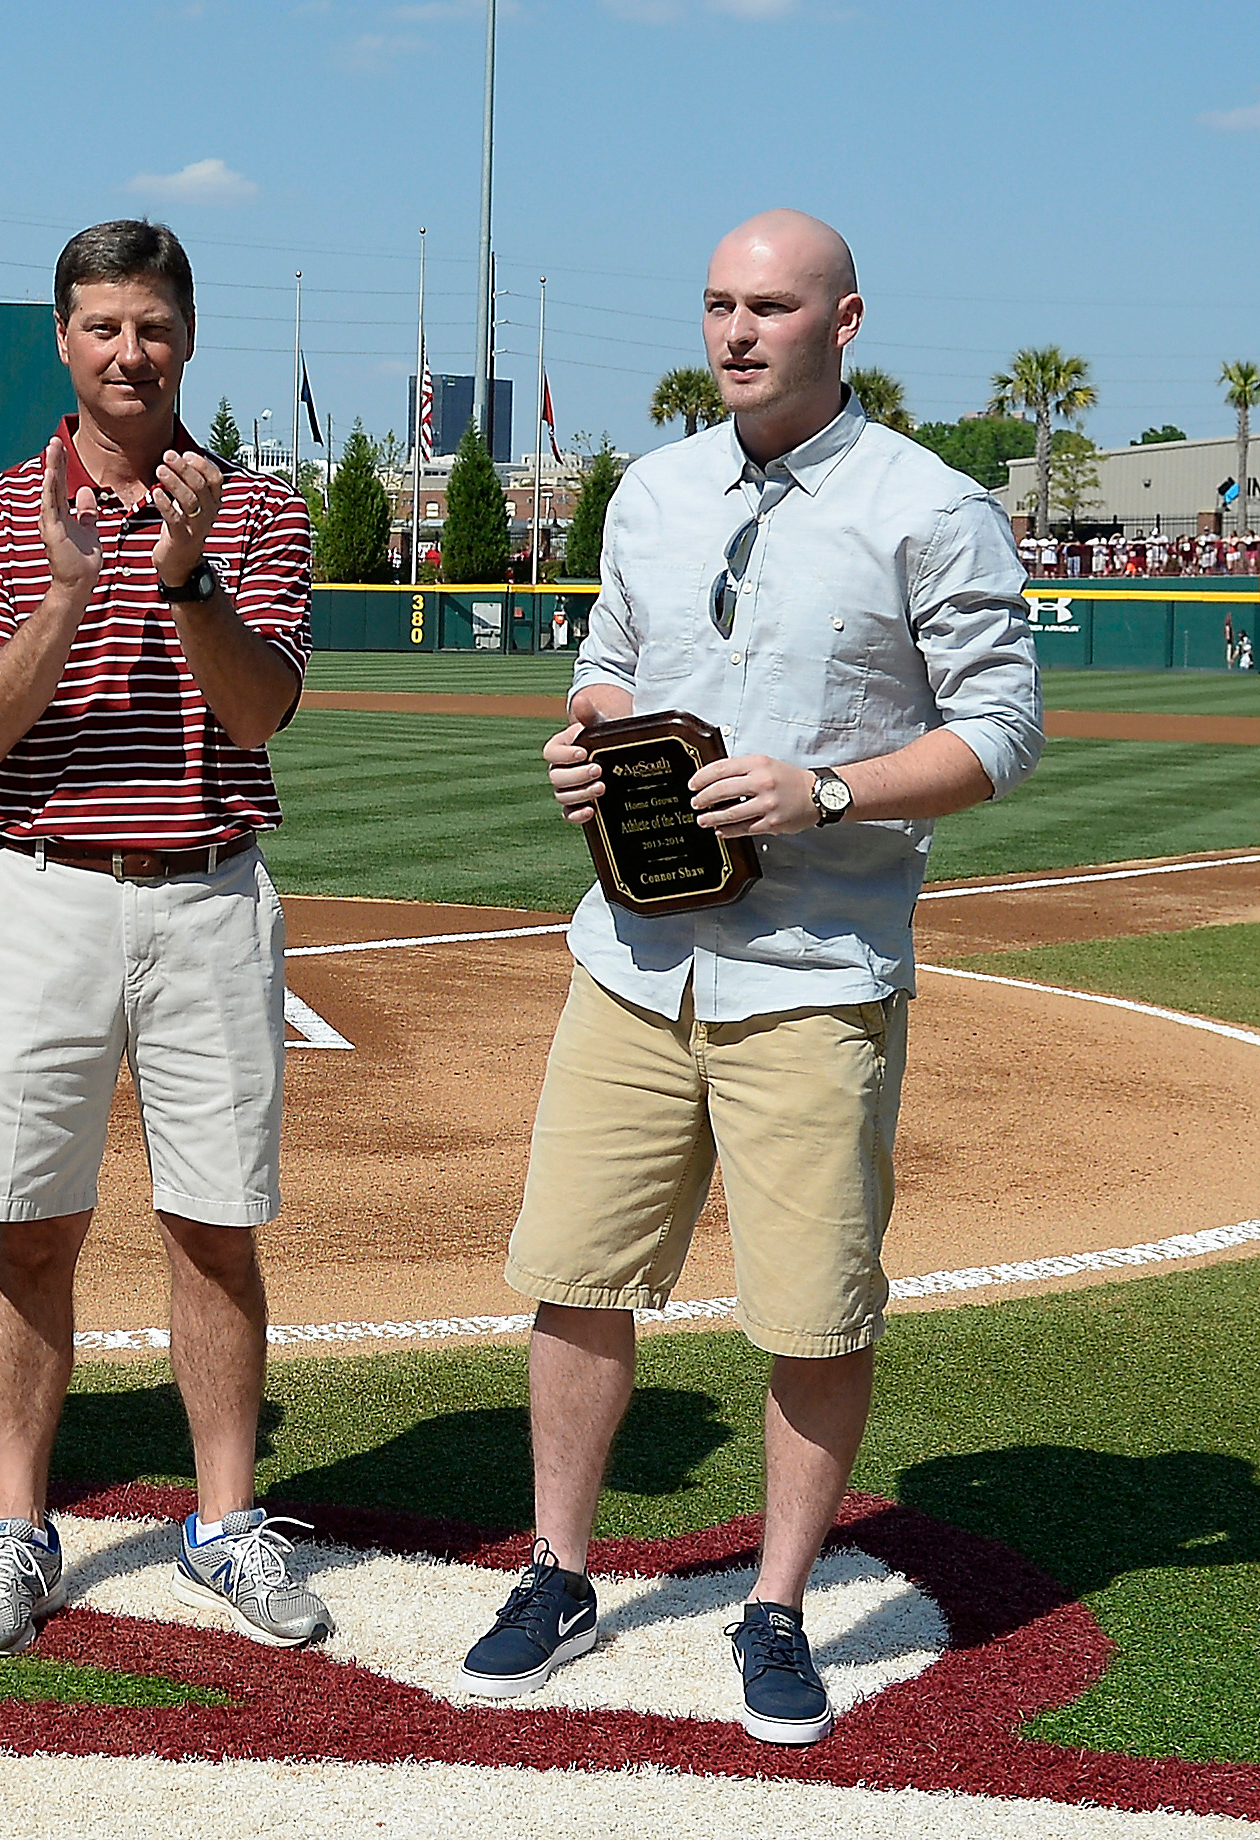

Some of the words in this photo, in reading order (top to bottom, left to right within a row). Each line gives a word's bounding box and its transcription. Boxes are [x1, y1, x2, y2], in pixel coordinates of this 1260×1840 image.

[411, 594, 424, 644] 380
[624, 756, 671, 778] AgSouth
[624, 801, 649, 811] Home
[650, 796, 679, 807] Grown
[621, 818, 650, 834] Athlete
[651, 814, 661, 829] of
[661, 813, 675, 827] the
[674, 811, 694, 825] Year
[642, 836, 685, 850] 2013-2014
[640, 871, 677, 885] Connor
[678, 866, 705, 879] Shaw
